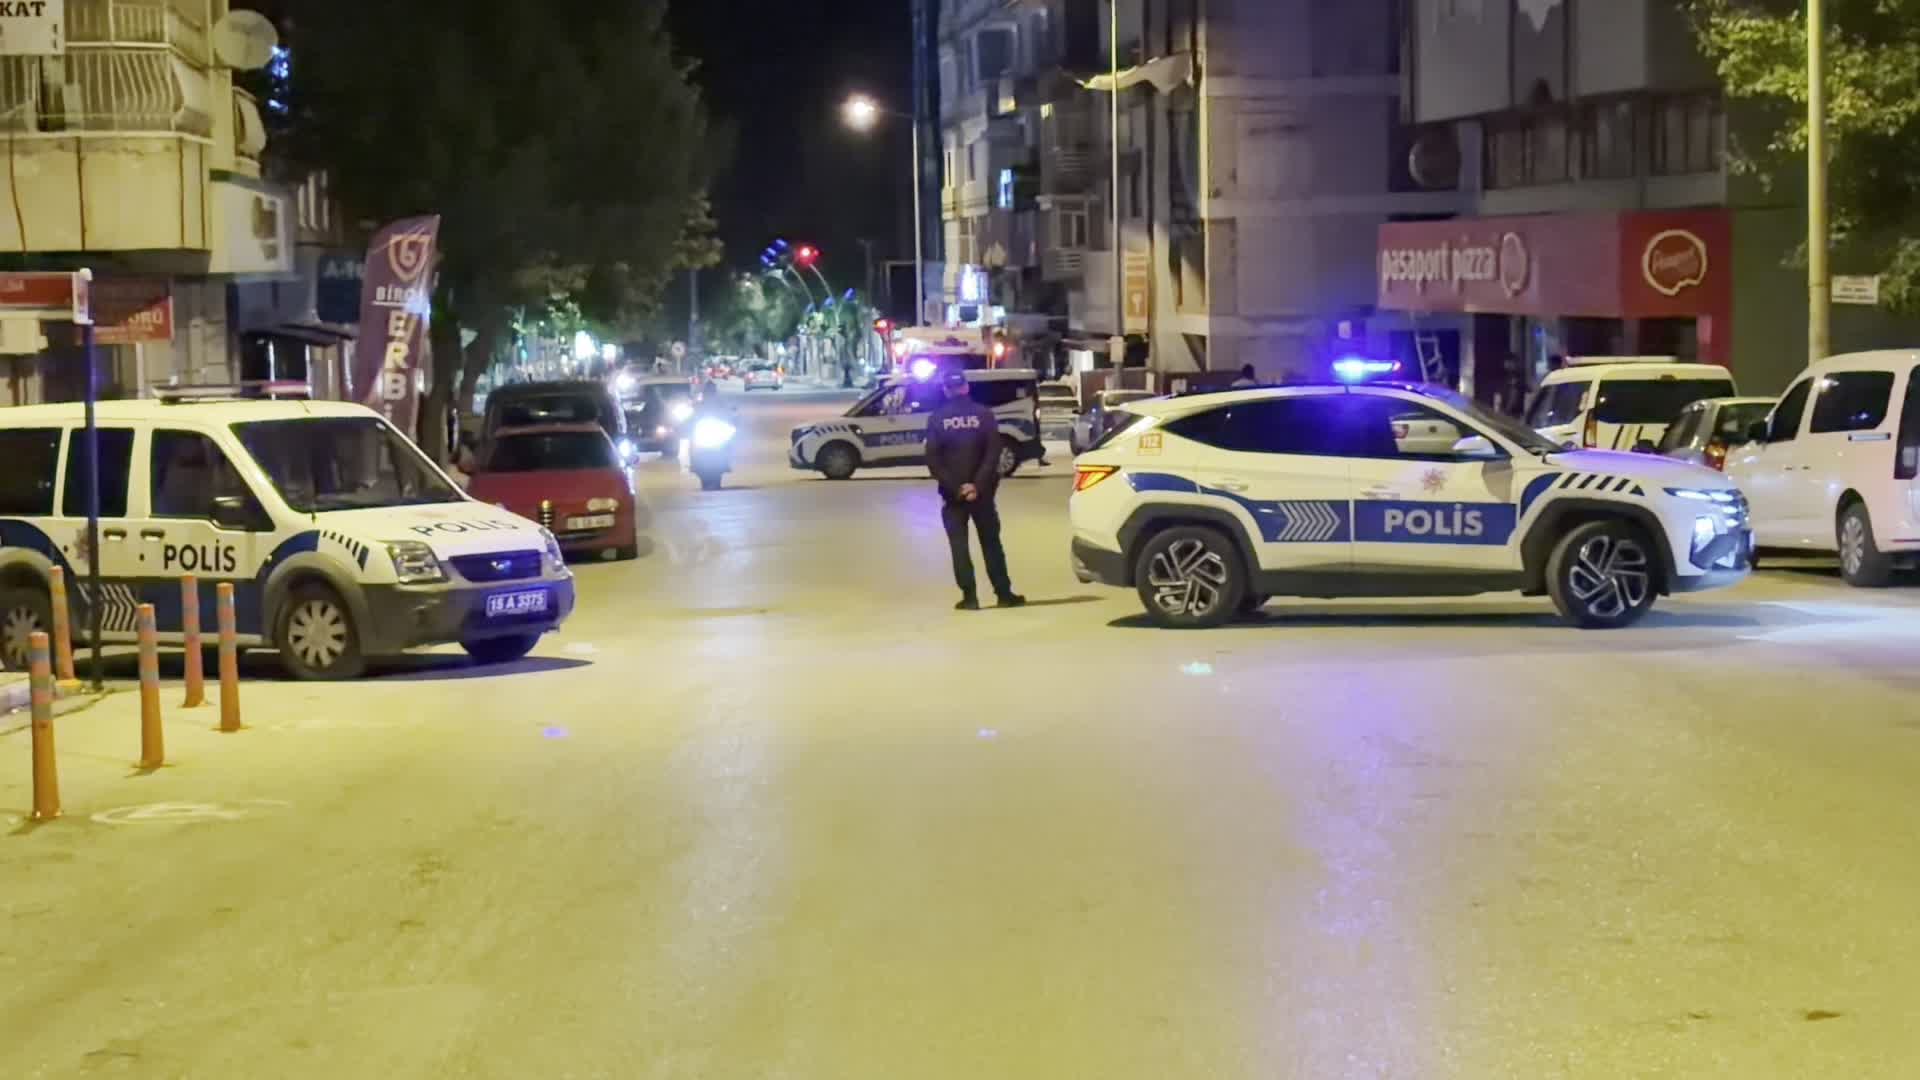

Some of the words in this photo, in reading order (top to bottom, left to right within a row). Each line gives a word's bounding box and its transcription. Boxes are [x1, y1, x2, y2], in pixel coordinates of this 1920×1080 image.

[0, 1, 46, 17] KAT
[1382, 241, 1448, 296] pasaport
[1452, 234, 1497, 294] pizza
[1384, 503, 1483, 536] POLİS
[163, 539, 236, 572] POLİS
